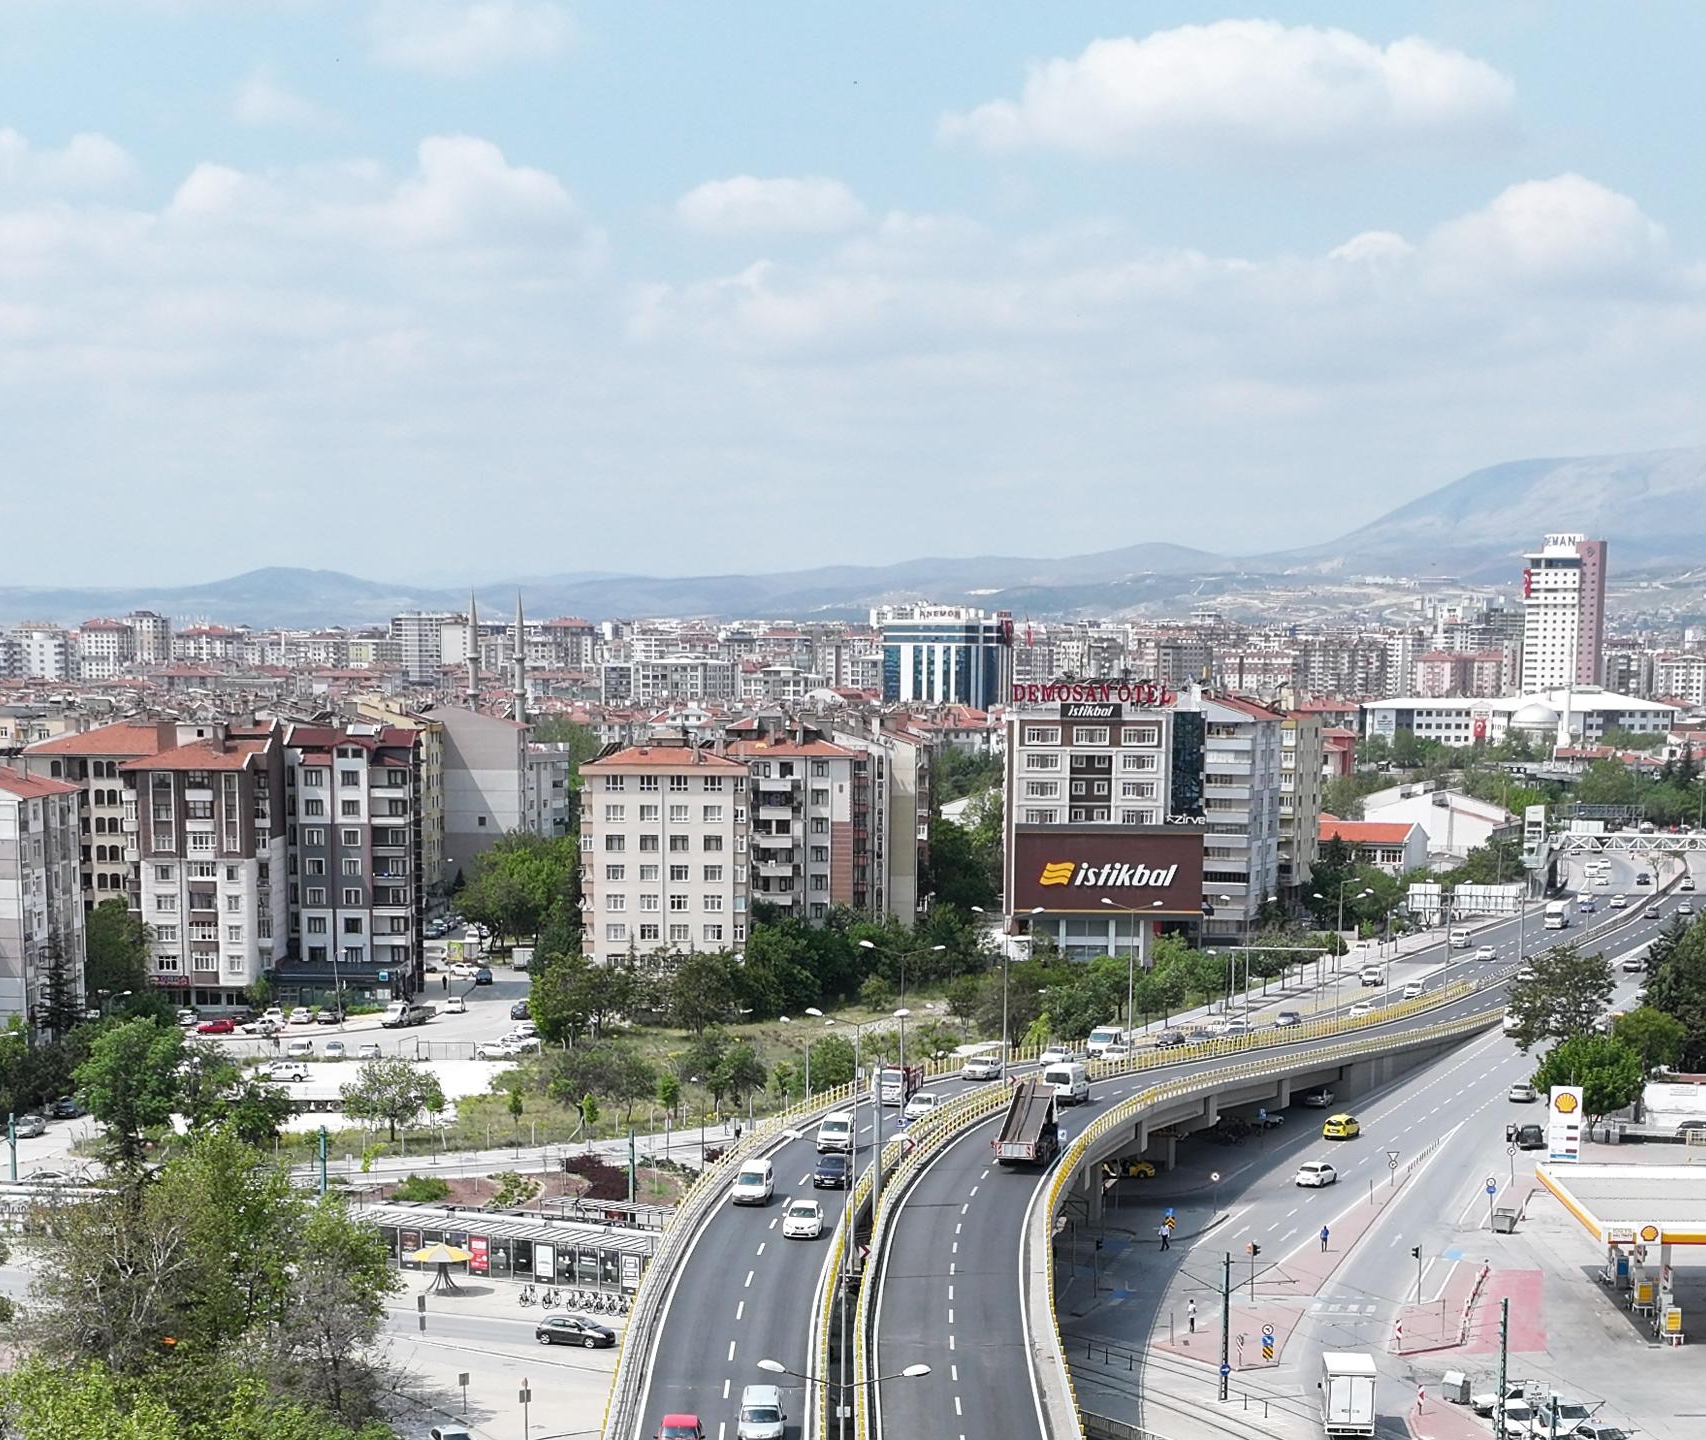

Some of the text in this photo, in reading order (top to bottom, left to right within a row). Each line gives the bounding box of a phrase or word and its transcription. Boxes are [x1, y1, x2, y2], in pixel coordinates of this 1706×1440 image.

[1012, 683, 1172, 704] DEMOSAN OTEL
[1067, 704, 1114, 718] istikbal
[1074, 862, 1179, 887] istikbal
